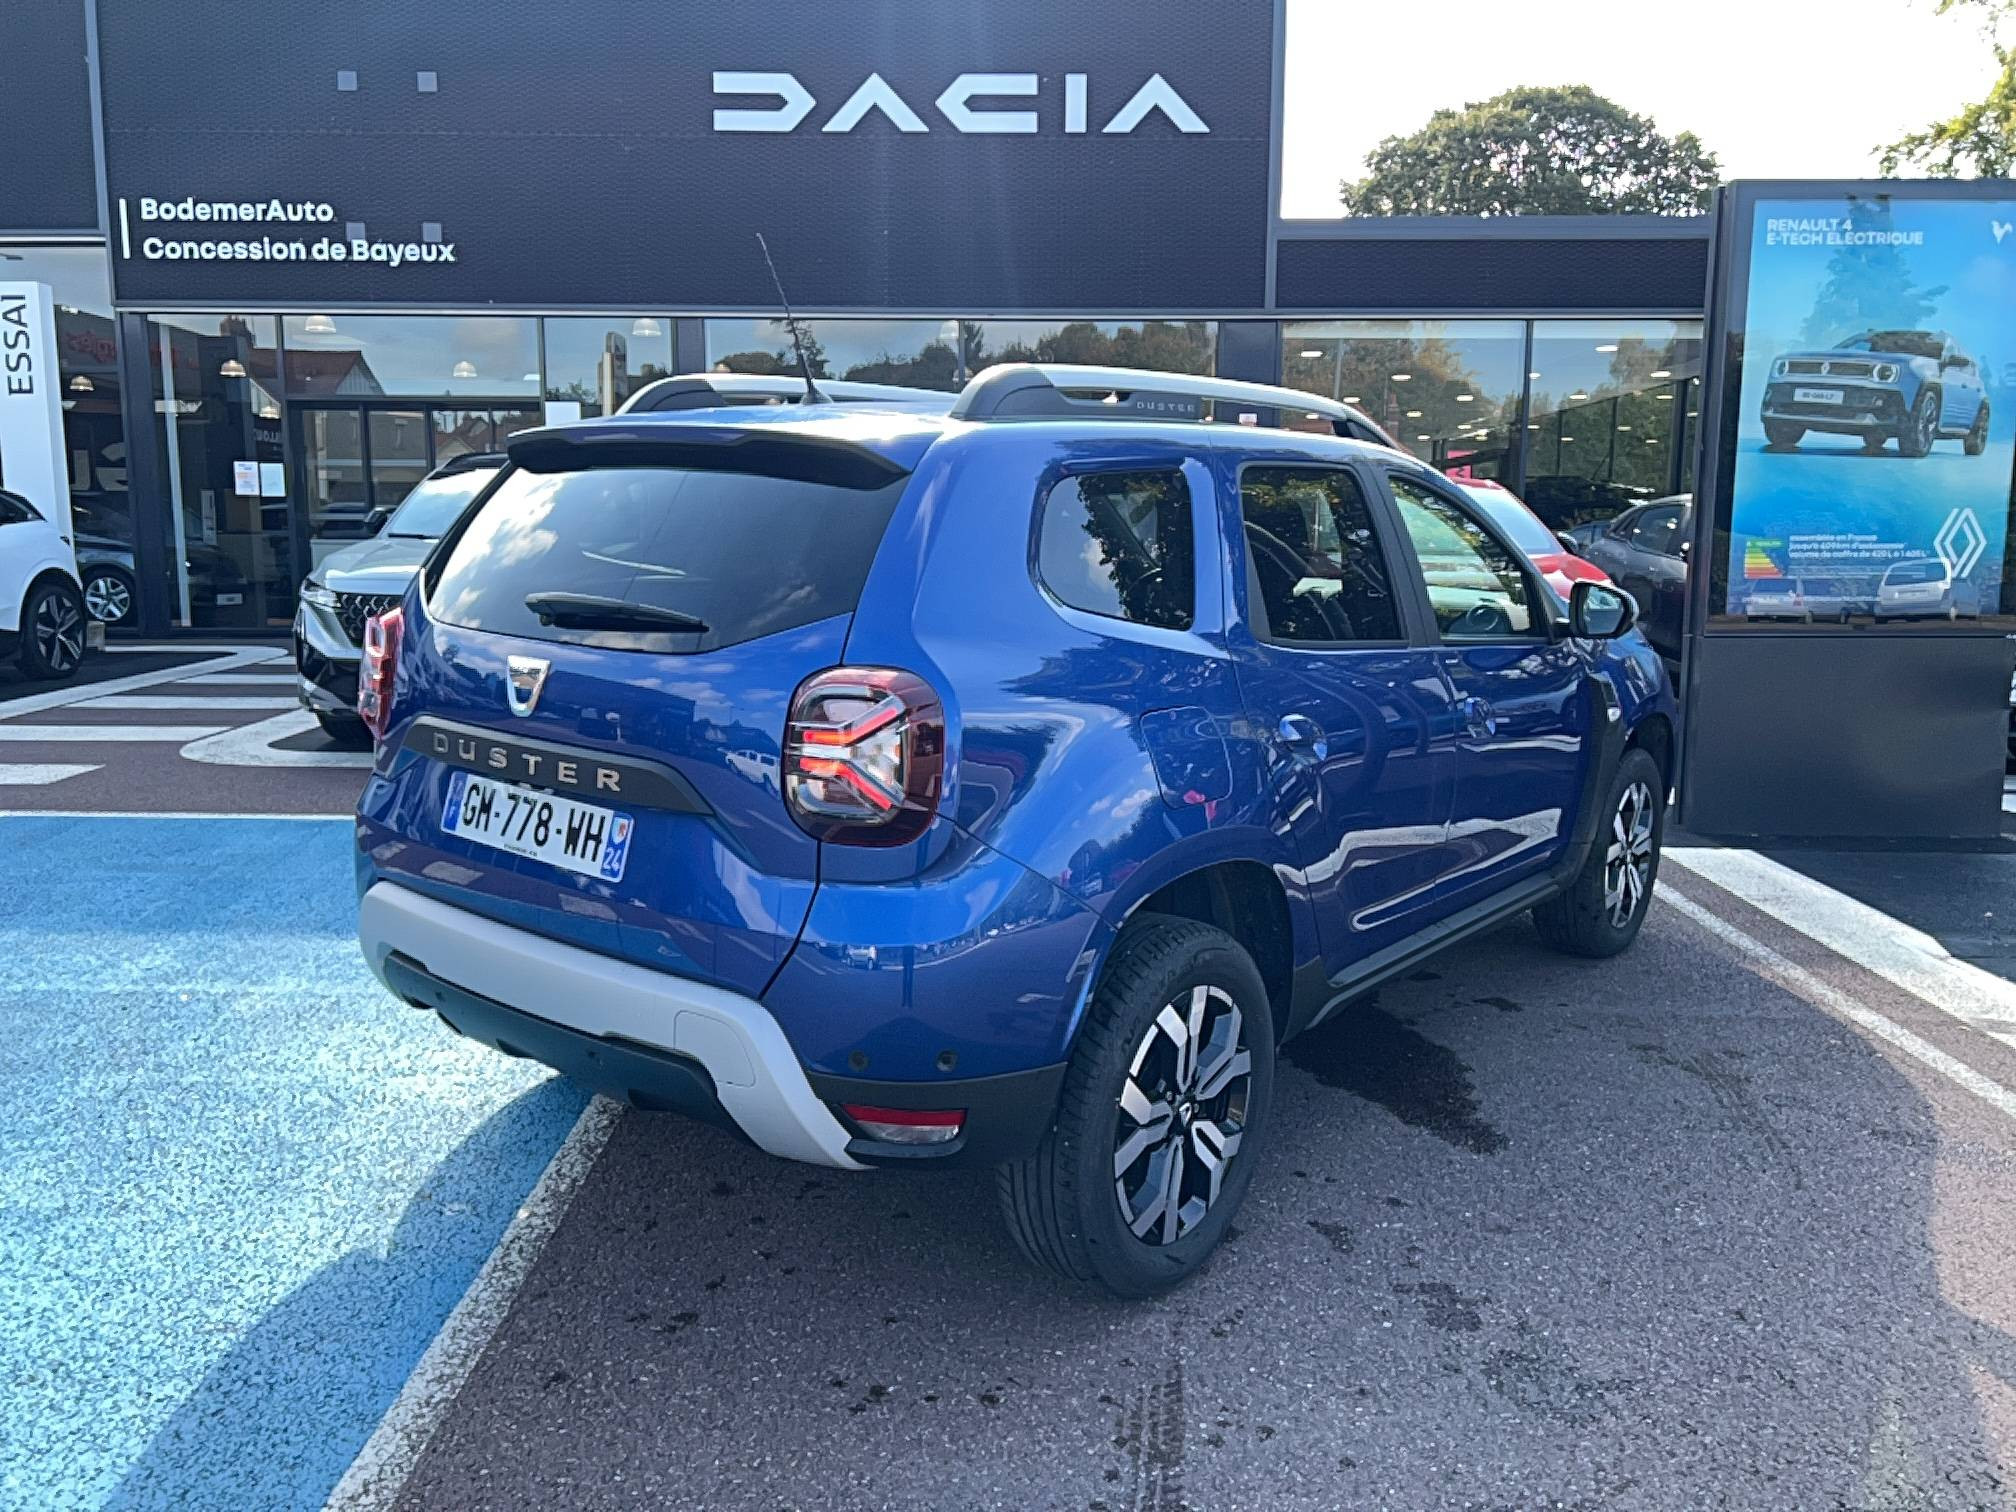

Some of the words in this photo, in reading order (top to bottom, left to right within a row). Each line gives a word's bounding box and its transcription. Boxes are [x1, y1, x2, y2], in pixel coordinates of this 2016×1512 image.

[713, 71, 1211, 134] DACIA
[140, 197, 335, 222] BodemerAuto
[1767, 218, 1841, 232] RENAULT
[1842, 219, 1853, 232] 4
[142, 236, 307, 261] Concession
[311, 238, 347, 261] de
[351, 239, 456, 267] Bayeux
[1766, 231, 1824, 246] E-TECH
[1, 294, 34, 396] ESSAI
[1136, 402, 1196, 413] DUSTER
[434, 732, 621, 792] DUSTER
[462, 783, 606, 862] GM-778-WH
[602, 847, 621, 871] 24
